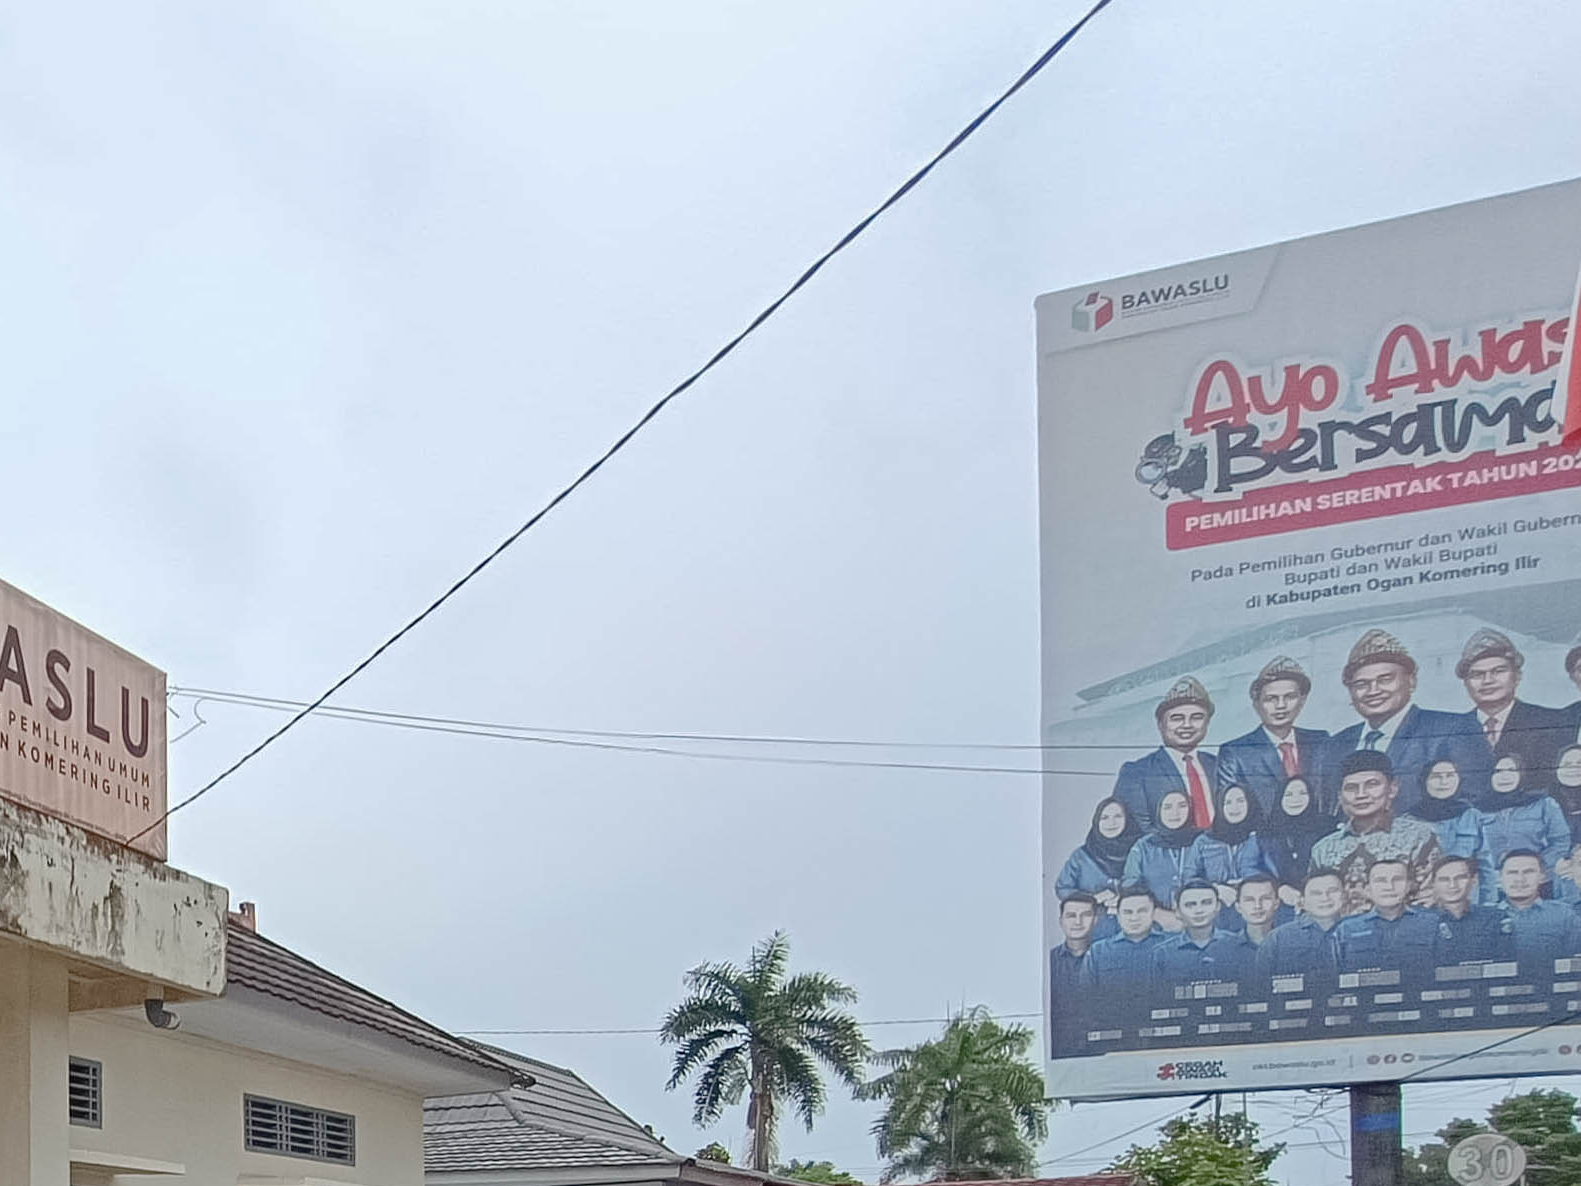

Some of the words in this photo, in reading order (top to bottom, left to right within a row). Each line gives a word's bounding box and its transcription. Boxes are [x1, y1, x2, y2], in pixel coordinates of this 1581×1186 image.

[1122, 274, 1229, 310] BAWASLU
[1183, 359, 1339, 453] Ayo
[1184, 497, 1312, 533] PEMILIHAN
[1317, 475, 1444, 511] SERENTAK
[1447, 460, 1538, 489] TAHUN
[1190, 565, 1234, 582] Pada
[1238, 552, 1325, 575] Pemilihan
[1330, 538, 1414, 561] Gubernur
[1418, 531, 1452, 548] dan
[1458, 521, 1508, 541] Wakil
[1245, 595, 1261, 609] di
[1266, 582, 1361, 606] Kabupaten
[1366, 574, 1413, 592] Ogan
[1419, 560, 1509, 583] Komering
[1515, 555, 1541, 570] Ilir
[1284, 565, 1340, 586] Bupati
[1346, 561, 1378, 577] dan
[1384, 550, 1433, 570] Wakil
[1439, 543, 1498, 563] Bupati
[8, 710, 102, 766] PEMILIHAN
[108, 757, 150, 788] UMUM
[18, 739, 111, 795] KOMERING
[117, 784, 150, 812] ILIR
[1459, 1143, 1514, 1181] 30
